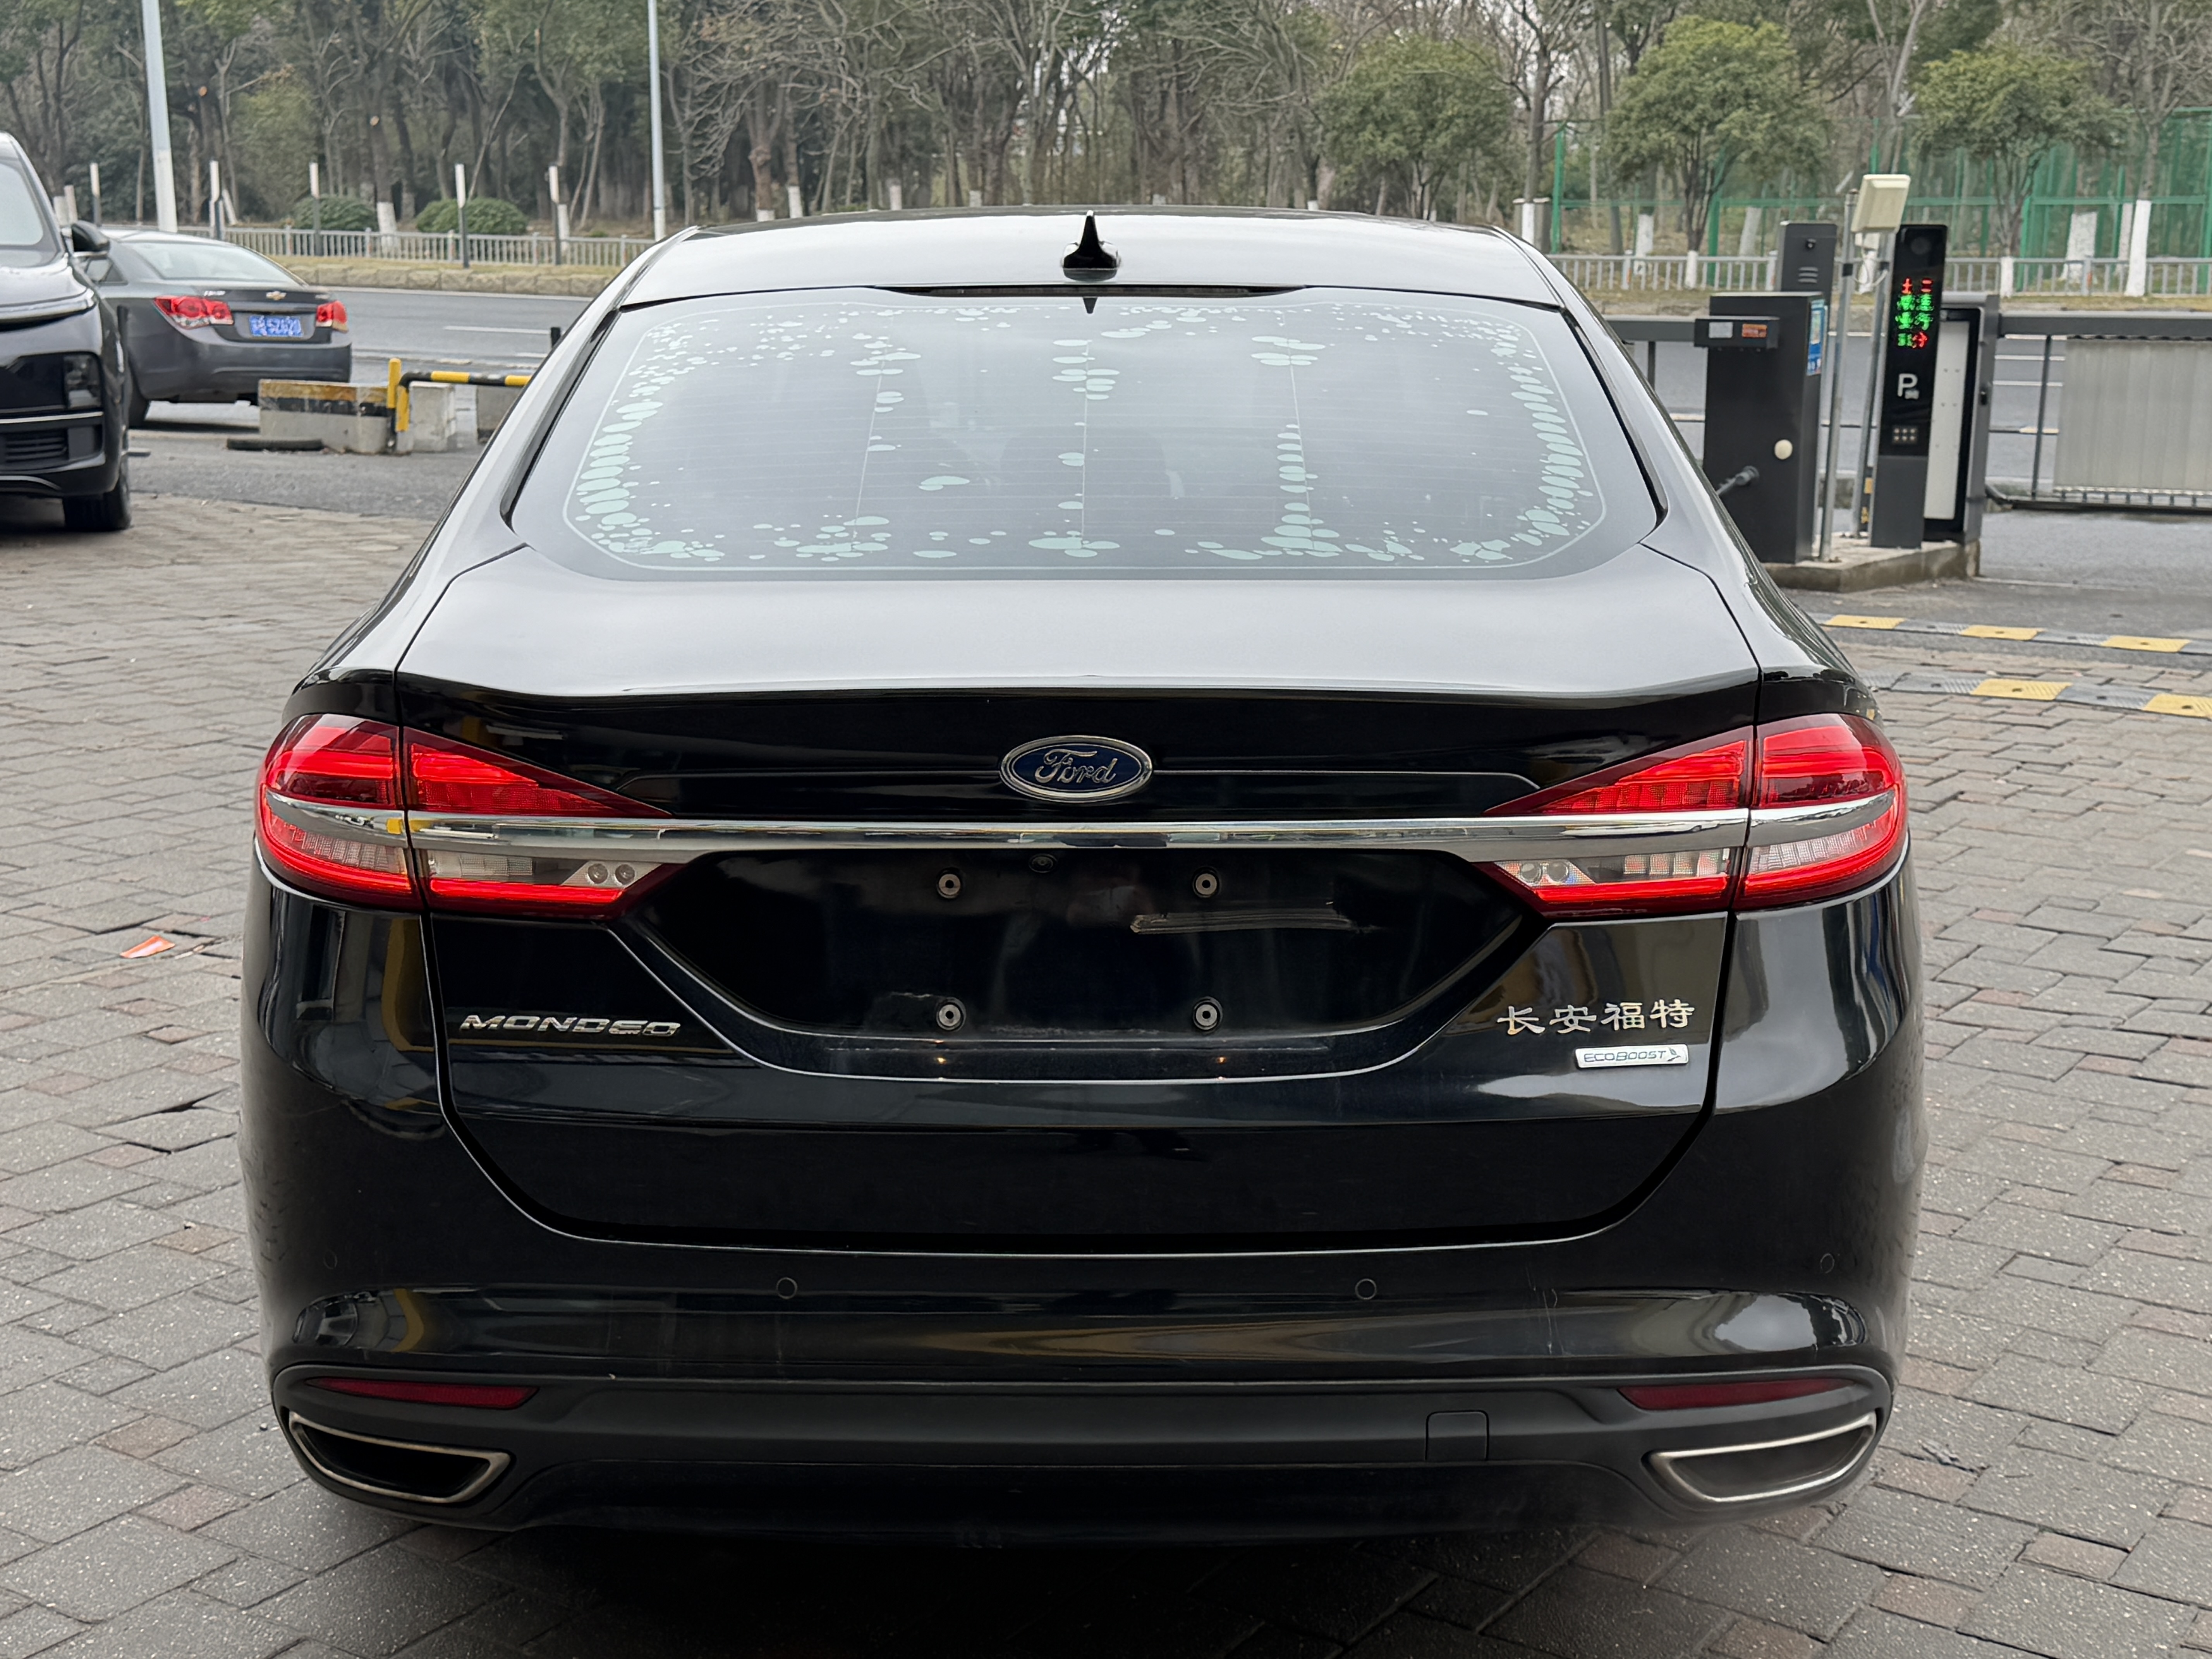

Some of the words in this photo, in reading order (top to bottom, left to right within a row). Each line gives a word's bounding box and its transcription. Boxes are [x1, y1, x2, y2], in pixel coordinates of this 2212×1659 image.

[1898, 373, 1918, 397] P
[1035, 749, 1118, 783] Ford
[459, 1014, 681, 1037] MONDEO
[1496, 999, 1695, 1036] 长安福特
[1584, 1050, 1667, 1063] ECOBOOST
